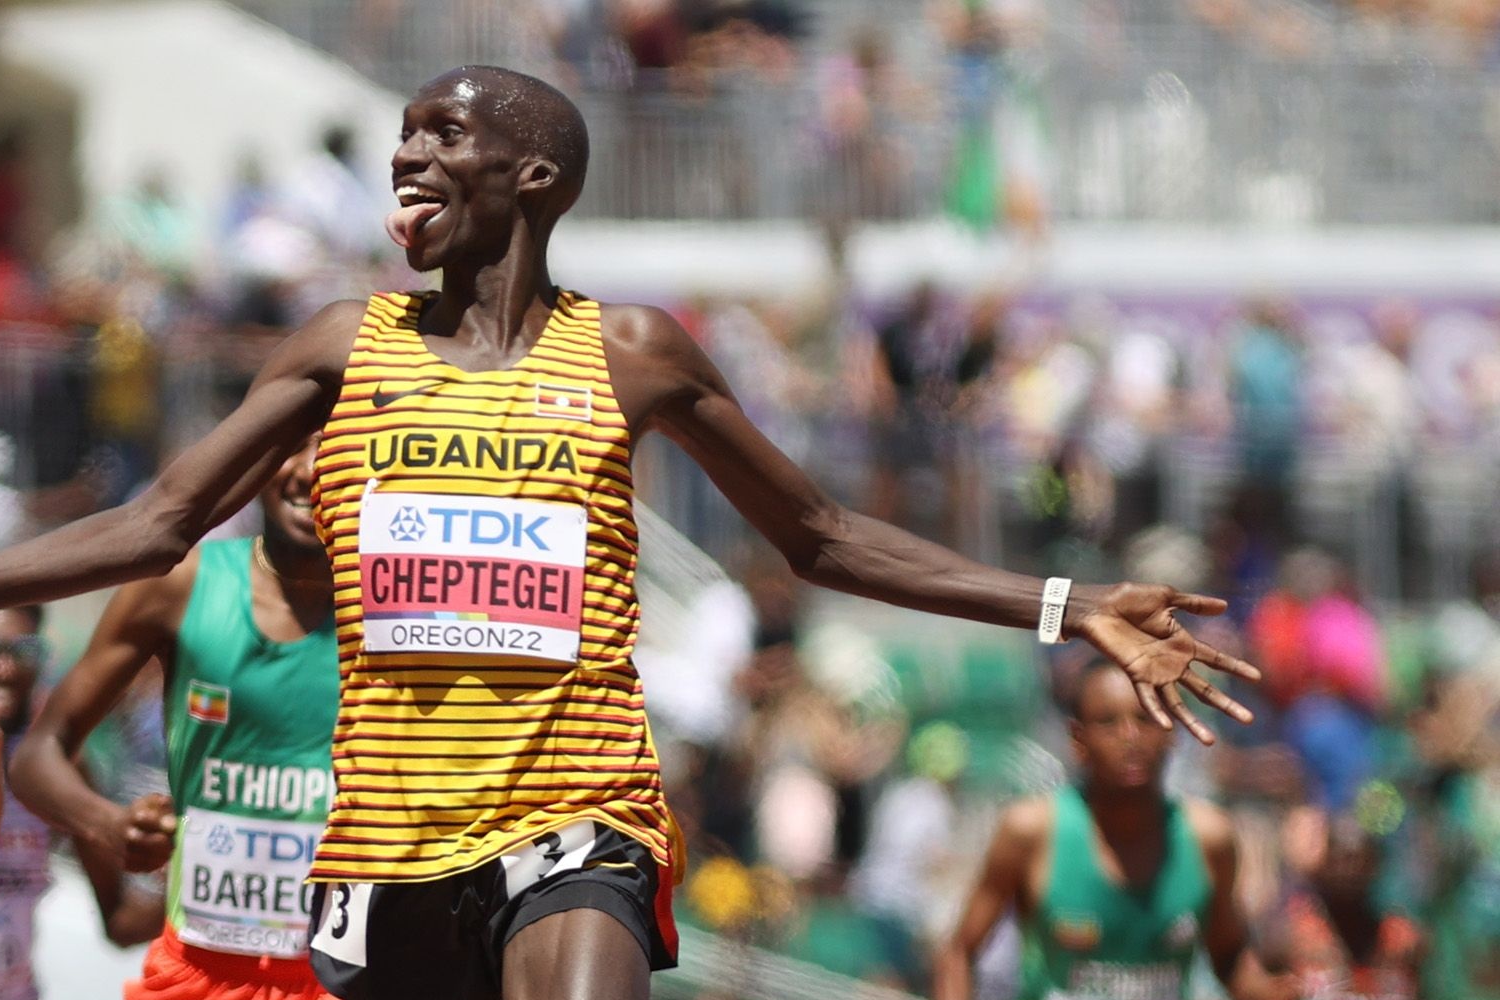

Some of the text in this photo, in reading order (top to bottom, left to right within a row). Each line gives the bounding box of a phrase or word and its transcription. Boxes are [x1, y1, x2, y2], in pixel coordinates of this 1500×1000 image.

[369, 434, 578, 476] UGANDA
[428, 508, 551, 551] TDK
[370, 557, 571, 614] CHEPTEGEI
[391, 624, 542, 652] OREGON22
[203, 758, 338, 814] ETHIOPI
[194, 864, 312, 914] BARE
